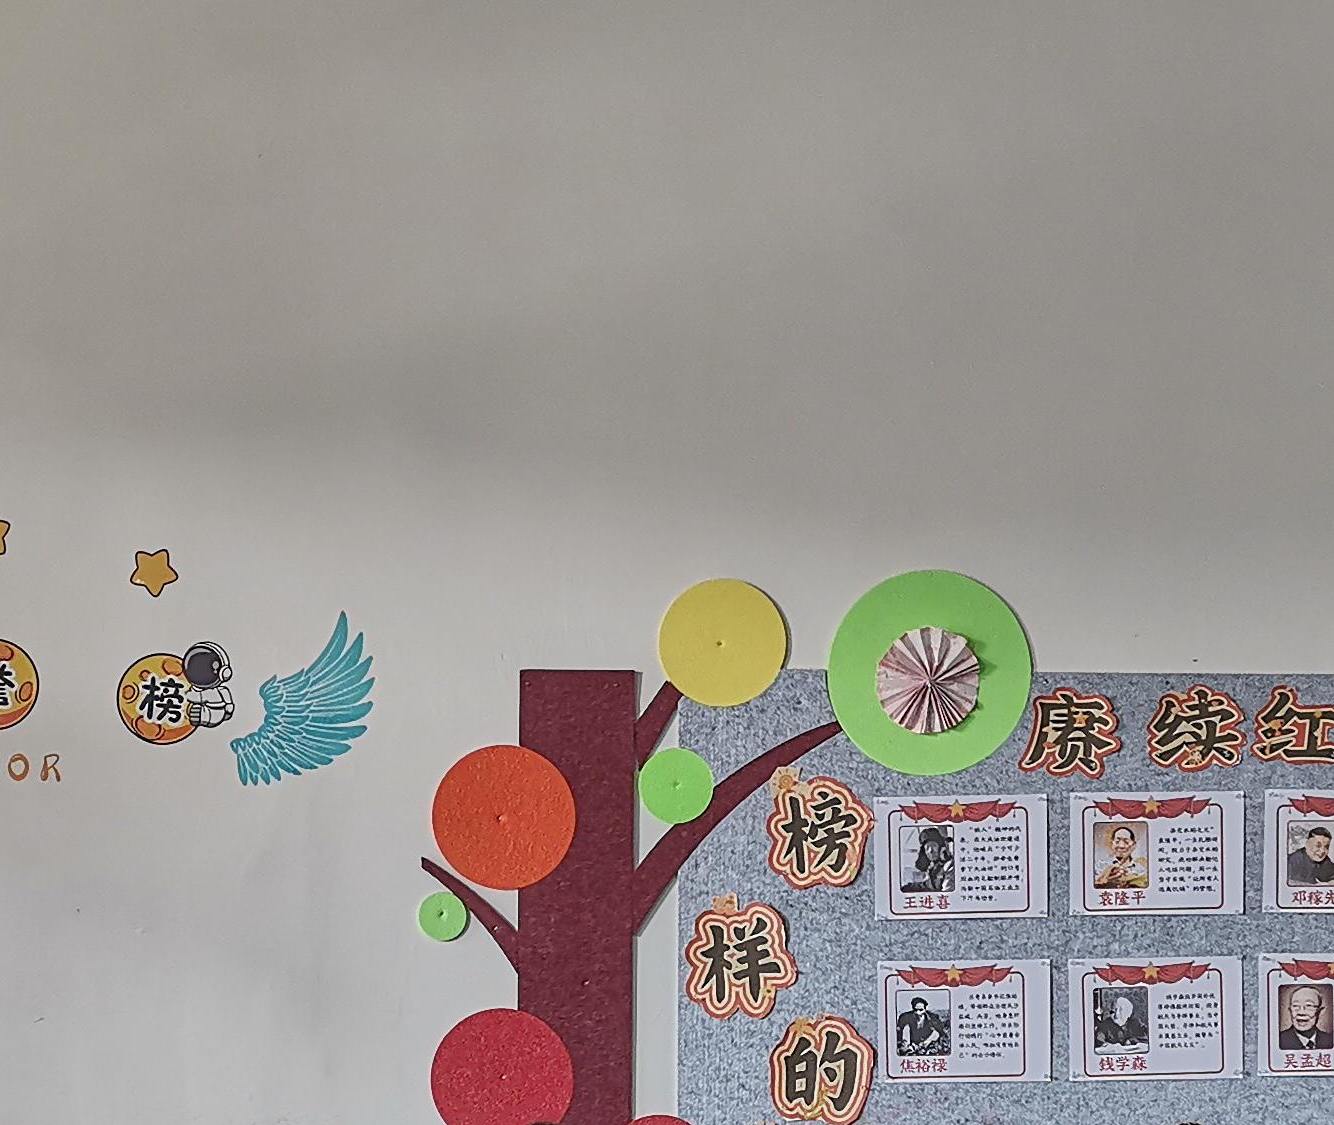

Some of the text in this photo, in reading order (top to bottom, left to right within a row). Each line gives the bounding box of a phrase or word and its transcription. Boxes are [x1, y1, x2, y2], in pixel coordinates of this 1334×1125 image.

[903, 894, 951, 910] 王进喜
[1098, 890, 1147, 907] 袁隆平
[899, 1058, 948, 1074] 焦裕禄
[1098, 1055, 1148, 1072] 钱学森
[1283, 1052, 1332, 1069] 吴孟超
